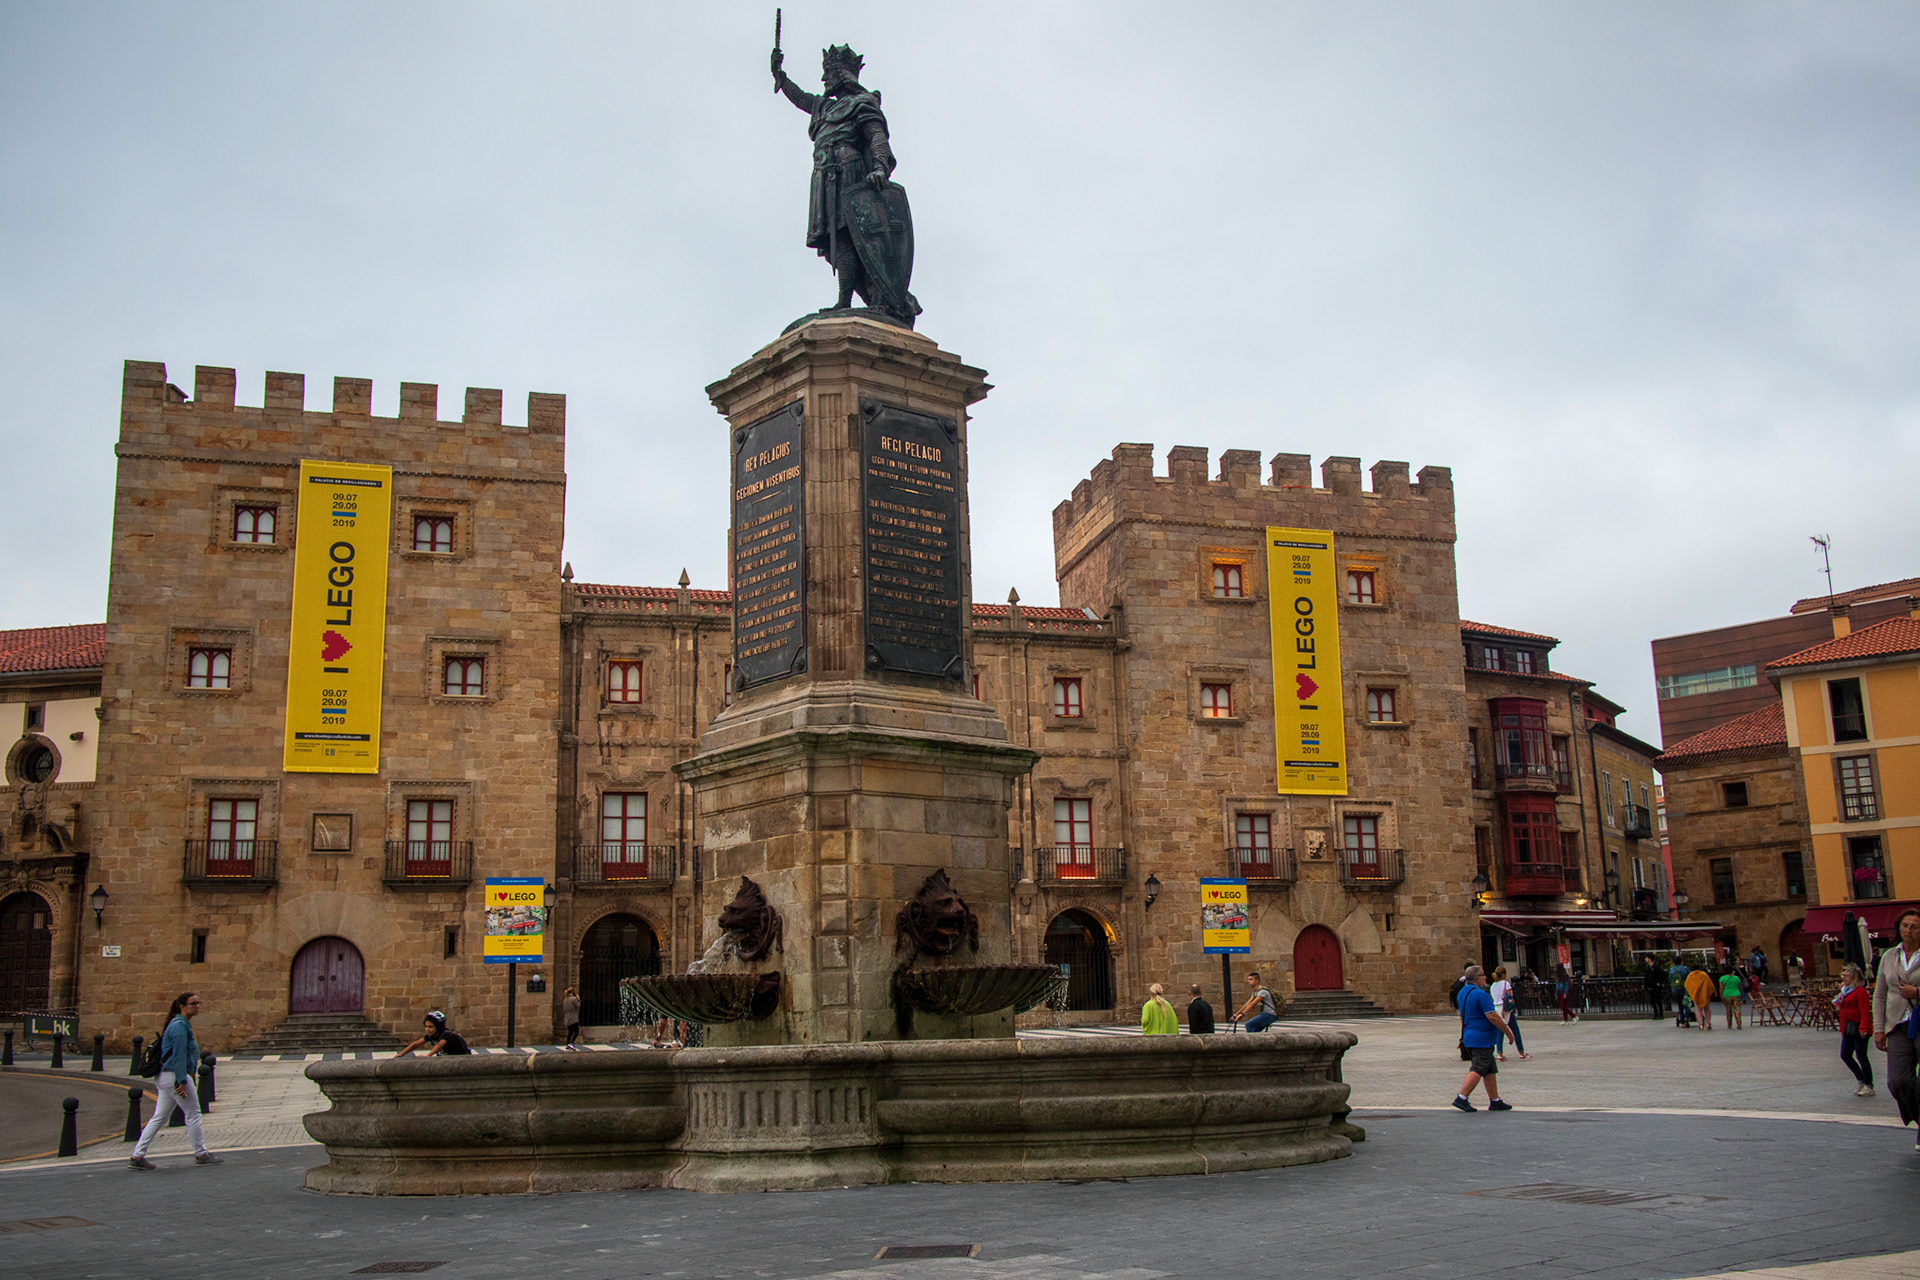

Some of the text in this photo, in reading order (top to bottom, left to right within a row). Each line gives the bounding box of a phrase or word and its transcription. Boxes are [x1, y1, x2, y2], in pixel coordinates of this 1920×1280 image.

[881, 436, 942, 463] REGI PELAGIO
[745, 441, 791, 473] REX PELAGIUS
[765, 465, 800, 489] VISENTIBUS
[332, 492, 357, 501] 09.07
[332, 501, 357, 510] 29.09
[332, 518, 355, 527] 2019
[1292, 554, 1310, 562] 09.07
[1292, 562, 1311, 570] 29.09
[1293, 577, 1311, 585] 2019
[323, 541, 355, 674] I LEGO
[1294, 596, 1316, 670] LEGO
[321, 689, 348, 698] 09.07
[321, 698, 347, 707] 29.09
[321, 716, 346, 725] 2019
[1300, 723, 1319, 731] 09.07
[1300, 731, 1320, 739] 29.09
[1302, 746, 1320, 754] 2019
[509, 892, 536, 901] LEGO
[1219, 891, 1242, 899] LEGO
[1821, 933, 1839, 943] Bar
